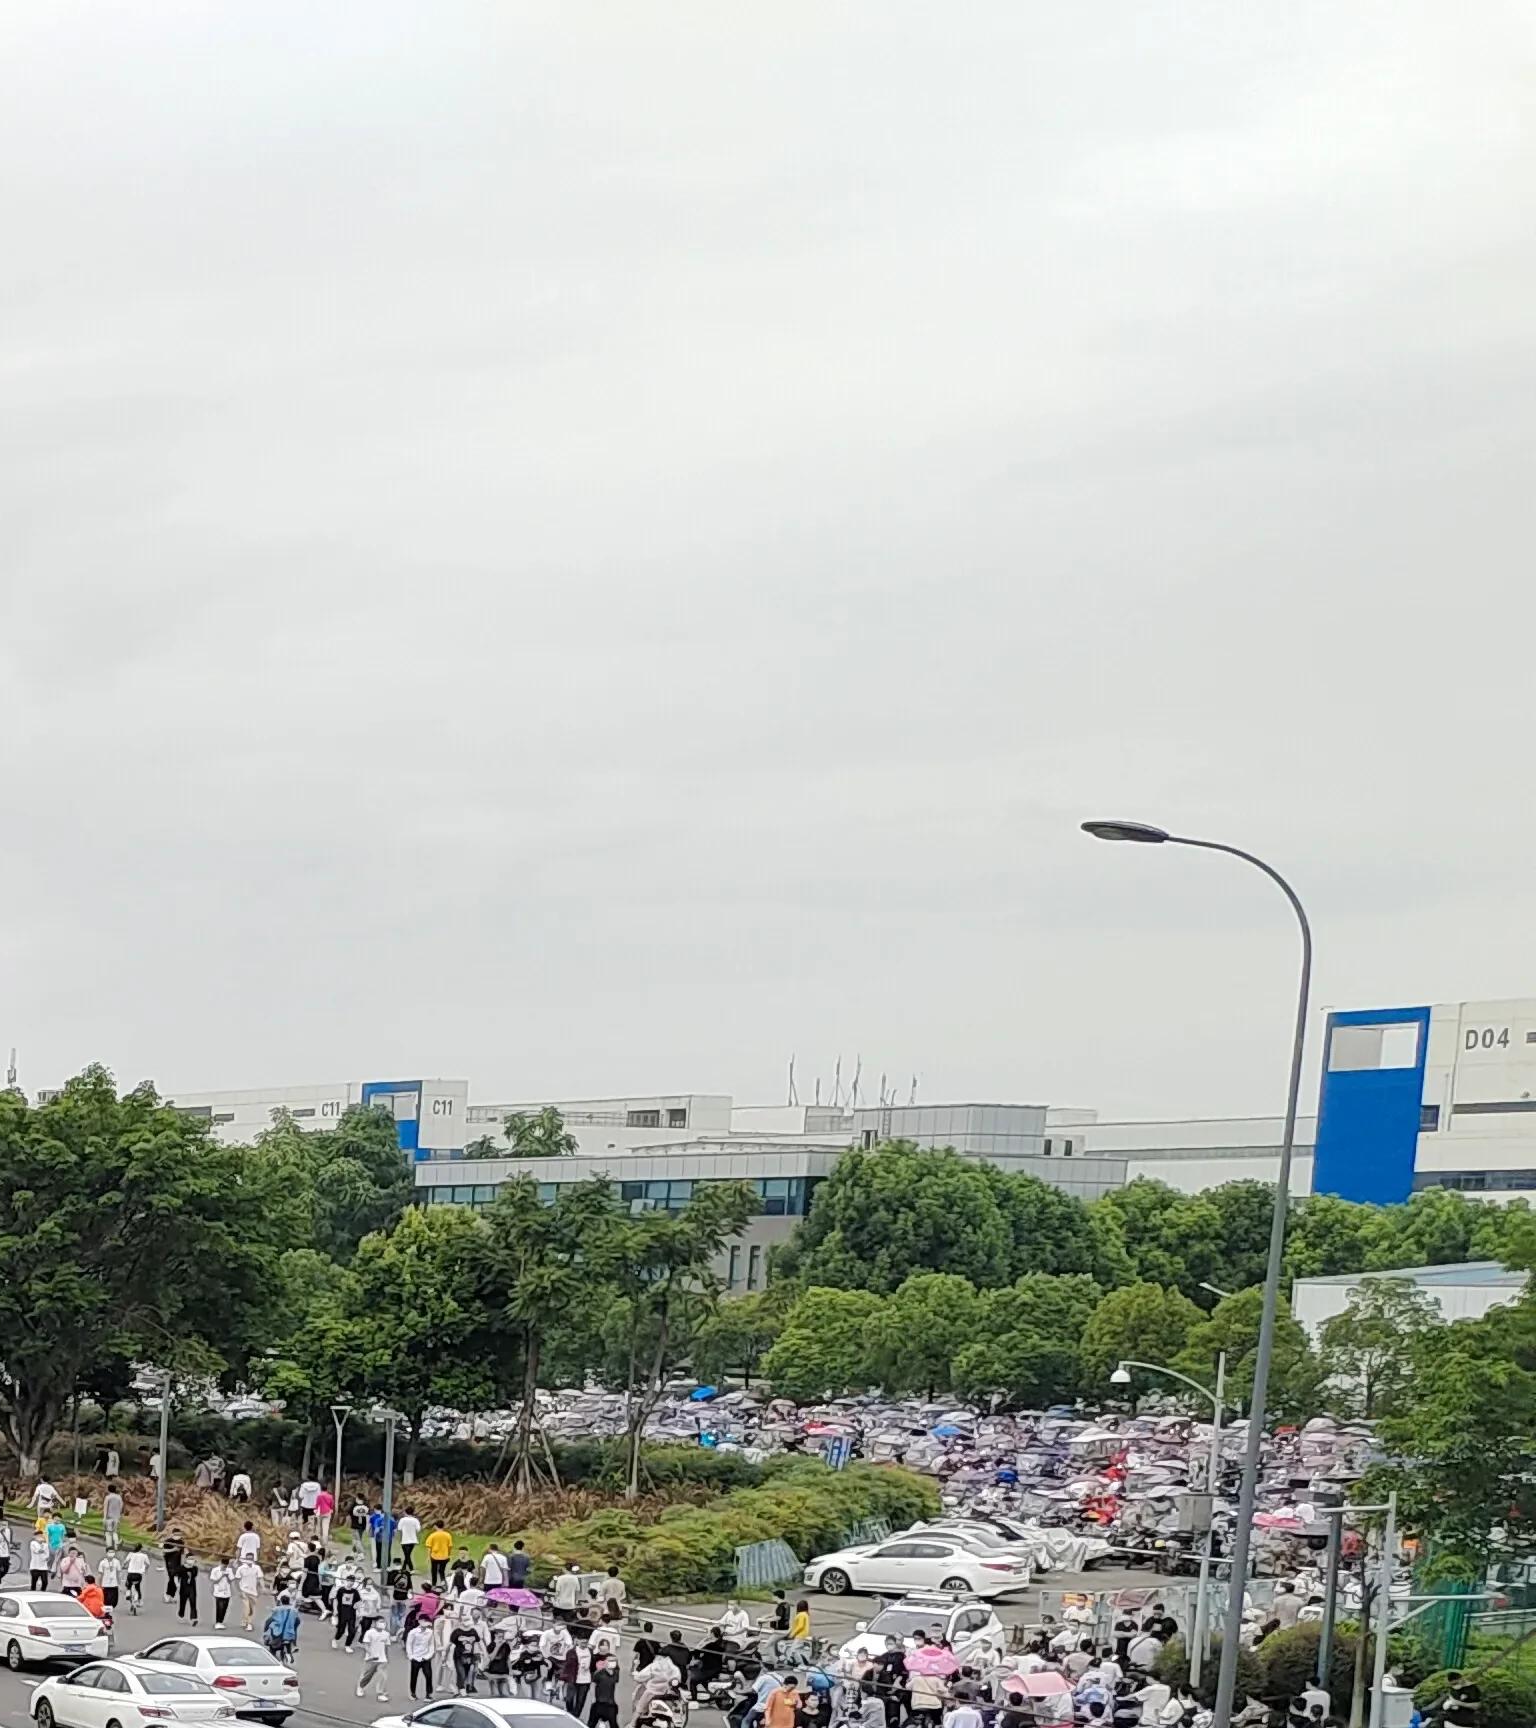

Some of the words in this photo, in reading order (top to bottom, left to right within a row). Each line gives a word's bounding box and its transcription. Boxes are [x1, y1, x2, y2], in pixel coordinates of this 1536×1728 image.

[1465, 1028, 1510, 1050] D04
[322, 1102, 340, 1117] C11
[432, 1099, 453, 1116] C11
